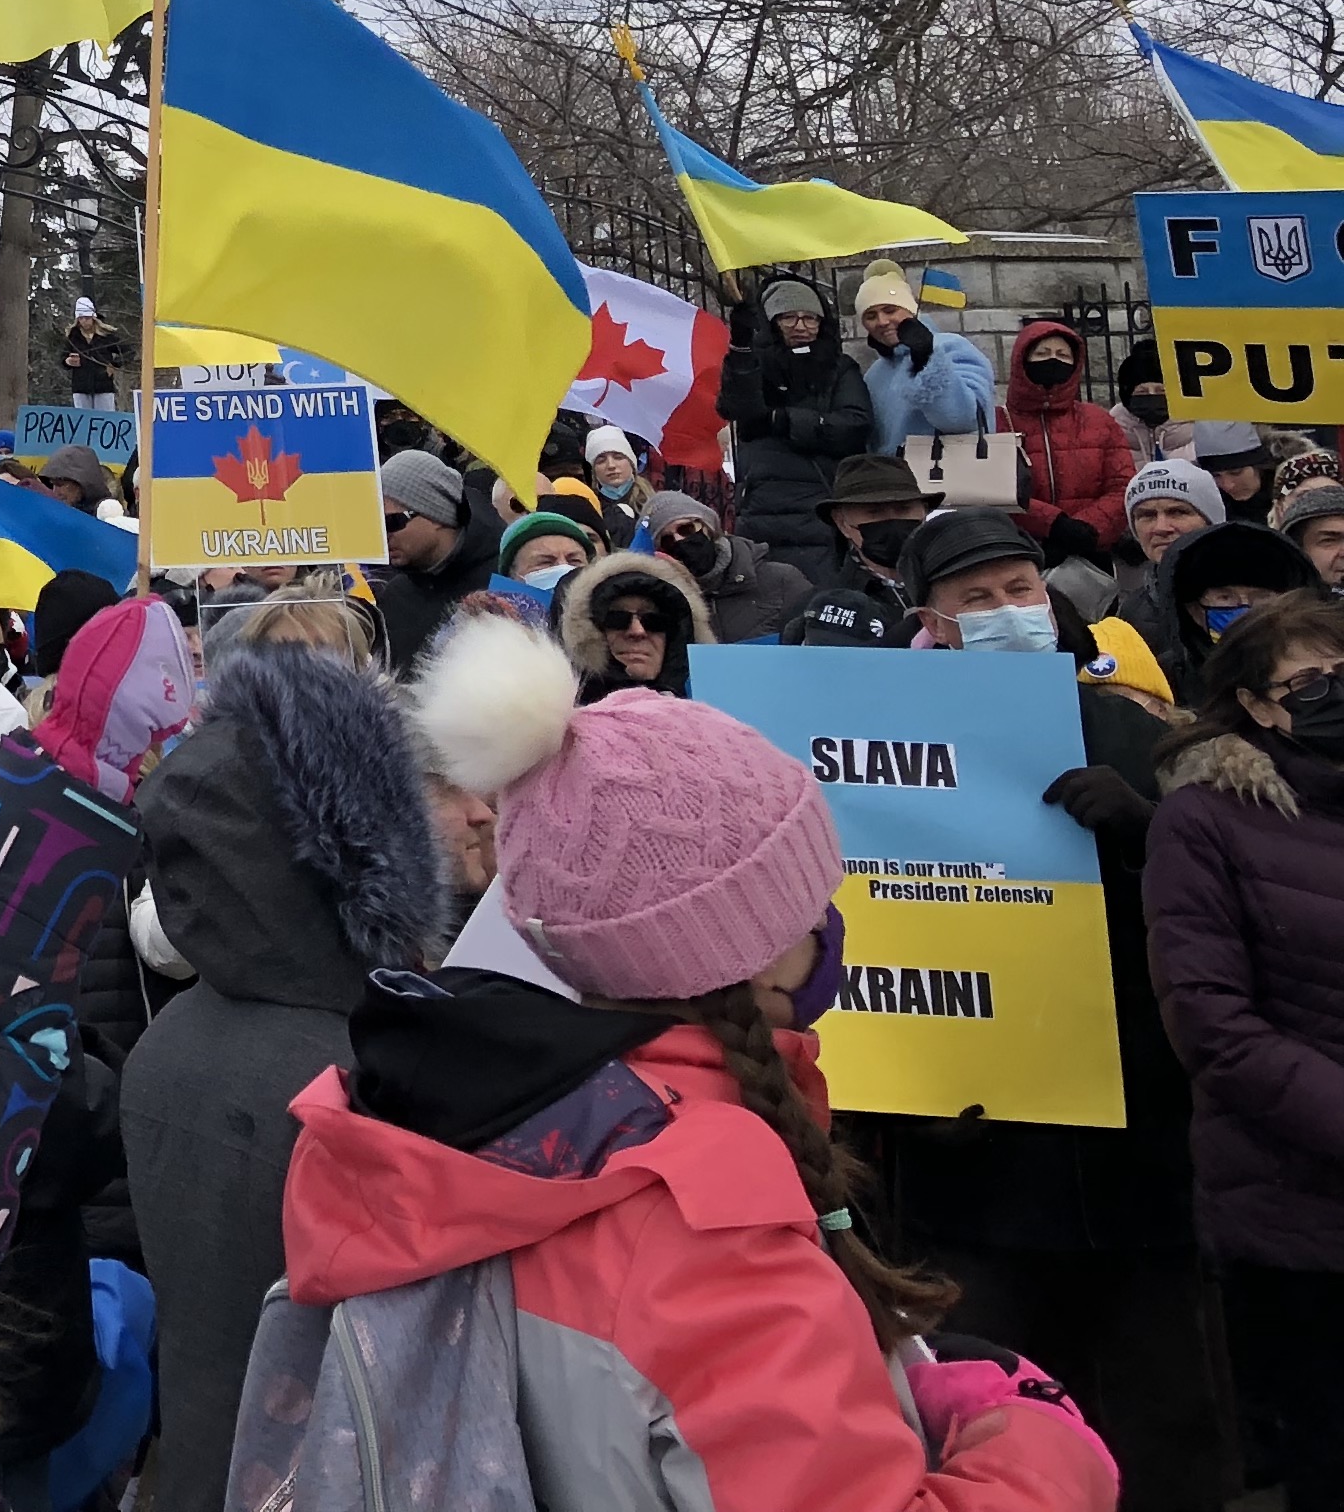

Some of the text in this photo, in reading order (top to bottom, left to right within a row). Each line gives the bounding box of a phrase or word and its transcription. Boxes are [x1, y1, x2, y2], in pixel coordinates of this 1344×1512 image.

[152, 390, 360, 423] WE STAND WITH
[24, 412, 132, 451] PRAY FOR
[201, 527, 330, 557] UKRAINE
[819, 613, 854, 628] NORTH
[837, 607, 857, 620] THE
[811, 736, 958, 788] SLAVA
[883, 858, 900, 875] is
[905, 862, 935, 877] our
[869, 879, 1055, 906] President Zelensky
[834, 965, 994, 1019] KRAINI
